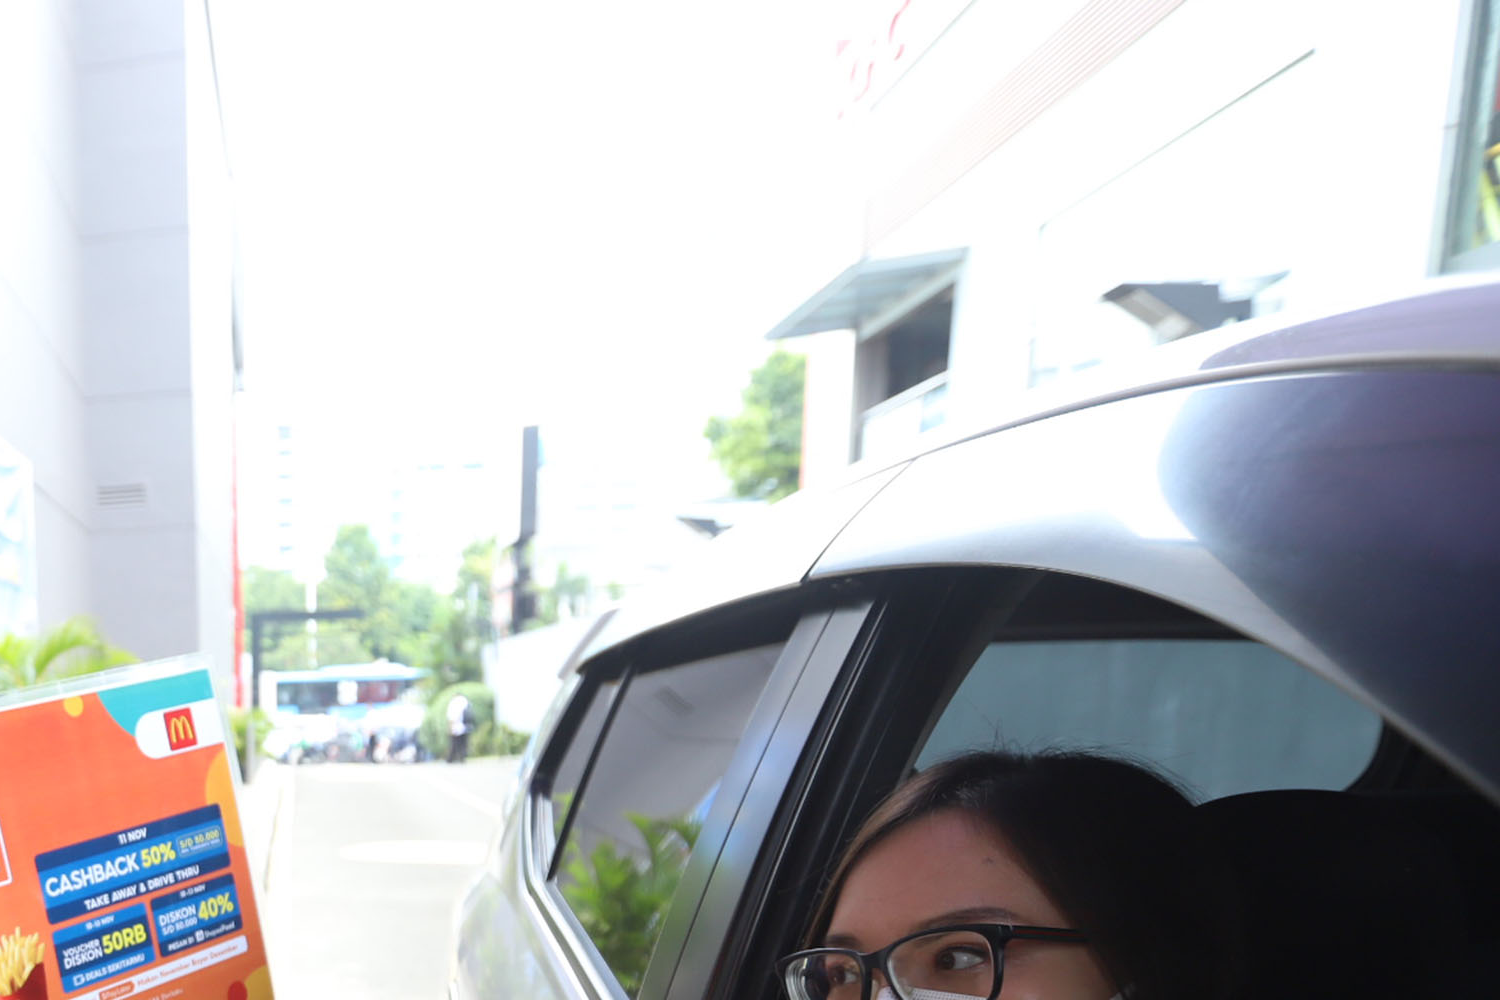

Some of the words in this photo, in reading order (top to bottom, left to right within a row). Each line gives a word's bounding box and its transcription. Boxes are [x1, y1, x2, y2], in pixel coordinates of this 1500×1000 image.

[128, 827, 148, 843] NOV
[45, 852, 140, 898] CASHBACK
[140, 841, 177, 868] 50%
[83, 892, 110, 911] TAKE
[111, 884, 138, 903] AWAY
[147, 872, 176, 891] DRIVE
[175, 864, 201, 881] THRU
[158, 904, 197, 926] DISKON
[198, 891, 235, 921] 40%
[62, 939, 100, 958] VOUCHER
[63, 946, 103, 970] DISKON
[102, 923, 148, 955] 50RB
[85, 966, 108, 982] DEALS
